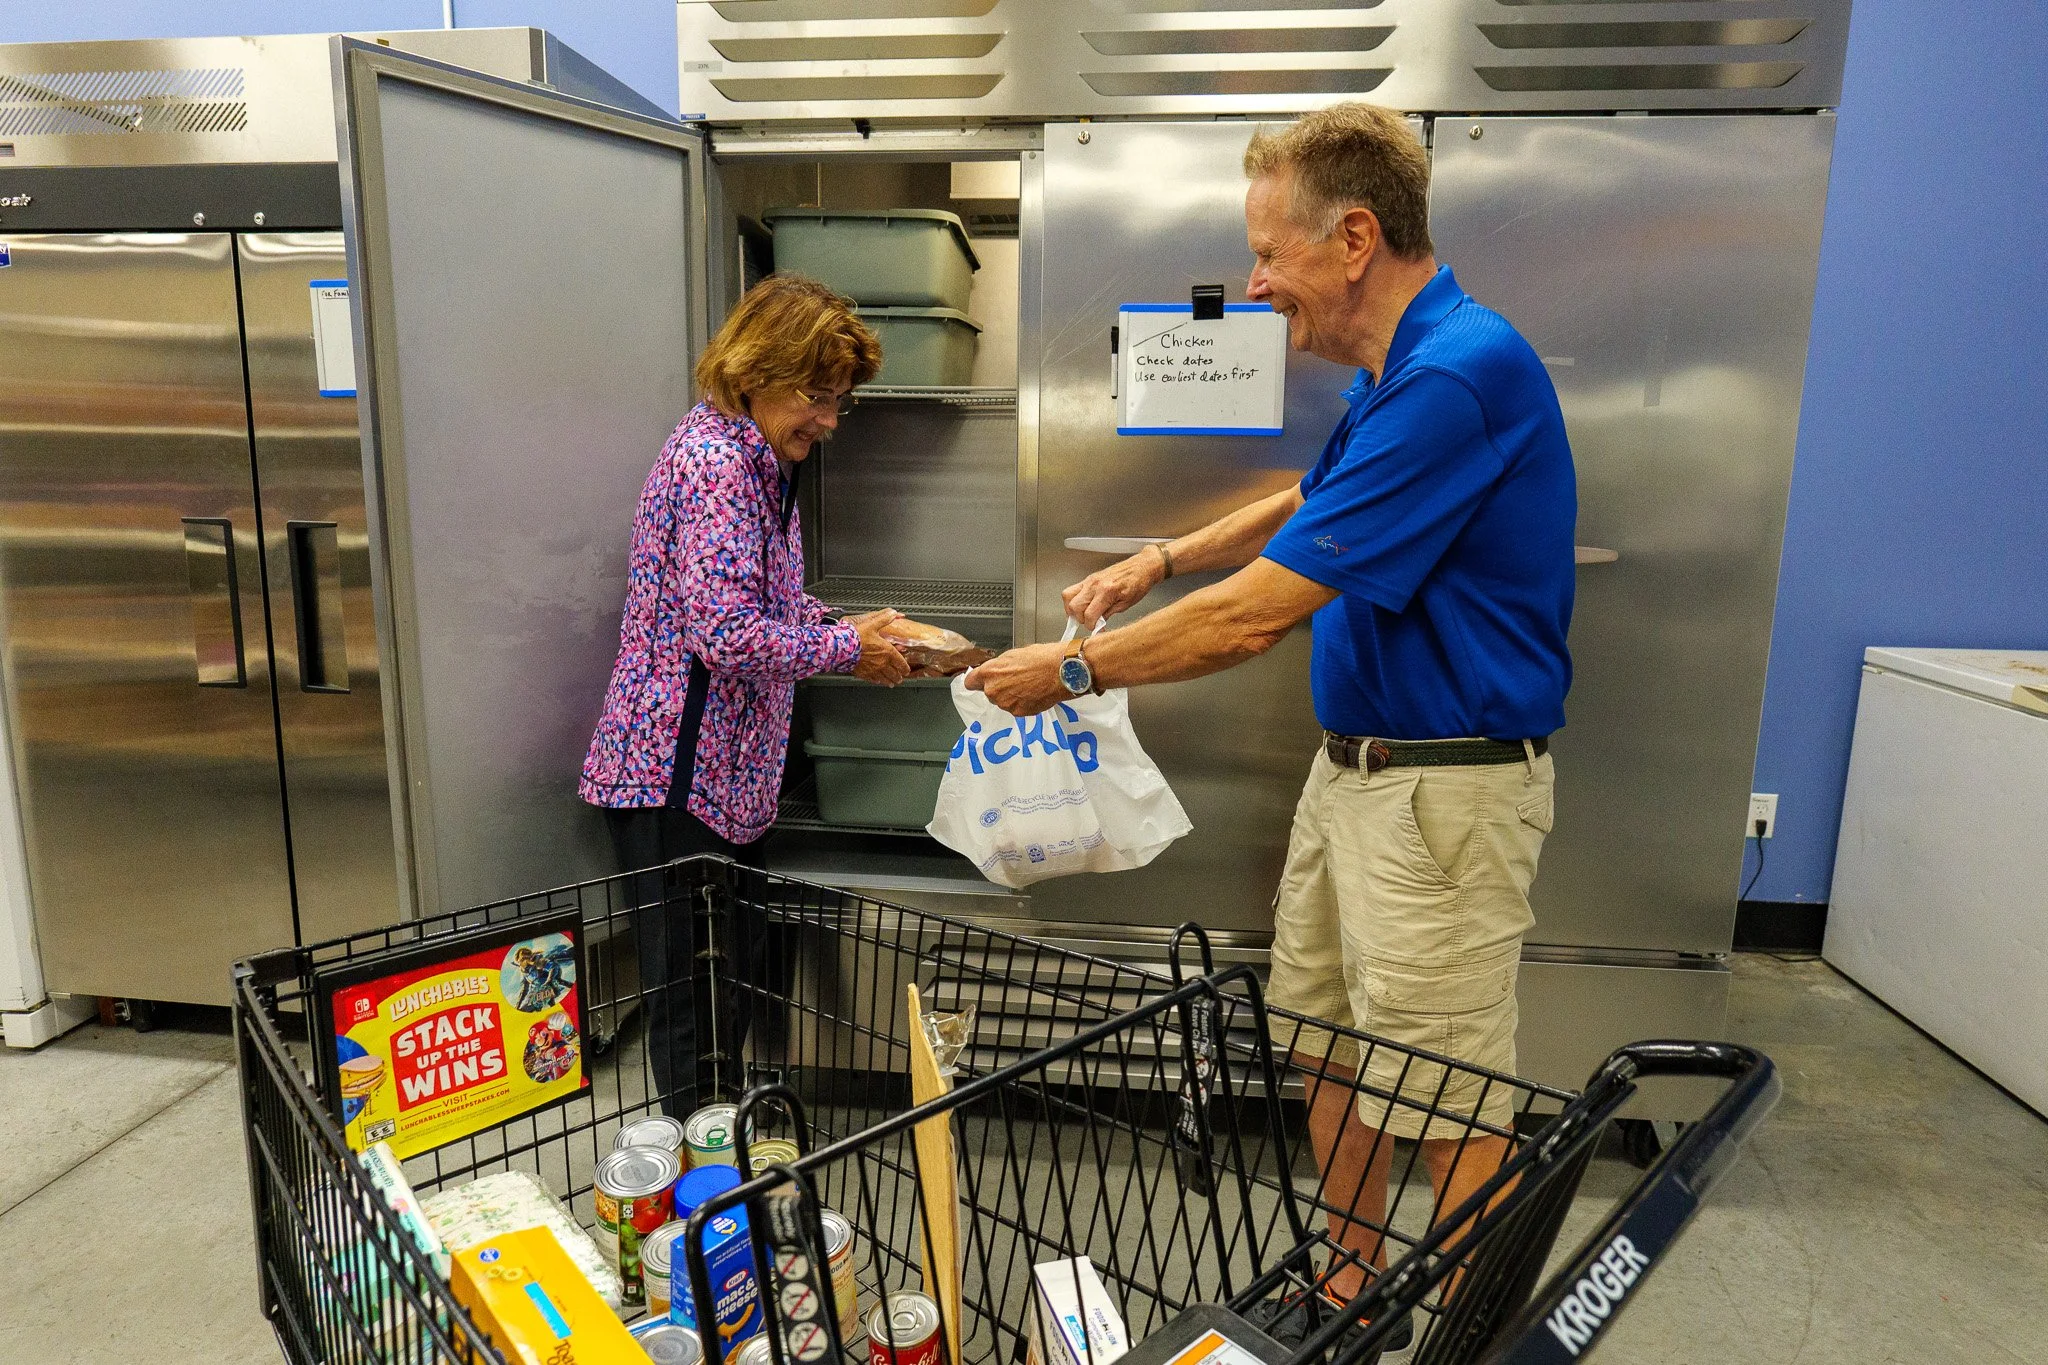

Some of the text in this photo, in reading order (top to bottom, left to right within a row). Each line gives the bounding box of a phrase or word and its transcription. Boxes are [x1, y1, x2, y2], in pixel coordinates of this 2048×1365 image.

[1160, 333, 1214, 349] Chicken
[1134, 366, 1259, 383] Use earliest dates first
[1136, 354, 1213, 366] Check dates
[390, 975, 490, 1022] LUNCHABLES
[397, 1007, 495, 1058] STACK
[416, 1037, 482, 1069] UP THE
[400, 1048, 503, 1103] WINS
[400, 1088, 510, 1131] LUNCHABLESSWEEPSTAKES.COM
[442, 1092, 469, 1107] VISIT
[716, 1283, 744, 1310] mac
[744, 1277, 756, 1293] &
[727, 1270, 745, 1287] Kraft
[1545, 1234, 1651, 1357] KROGER
